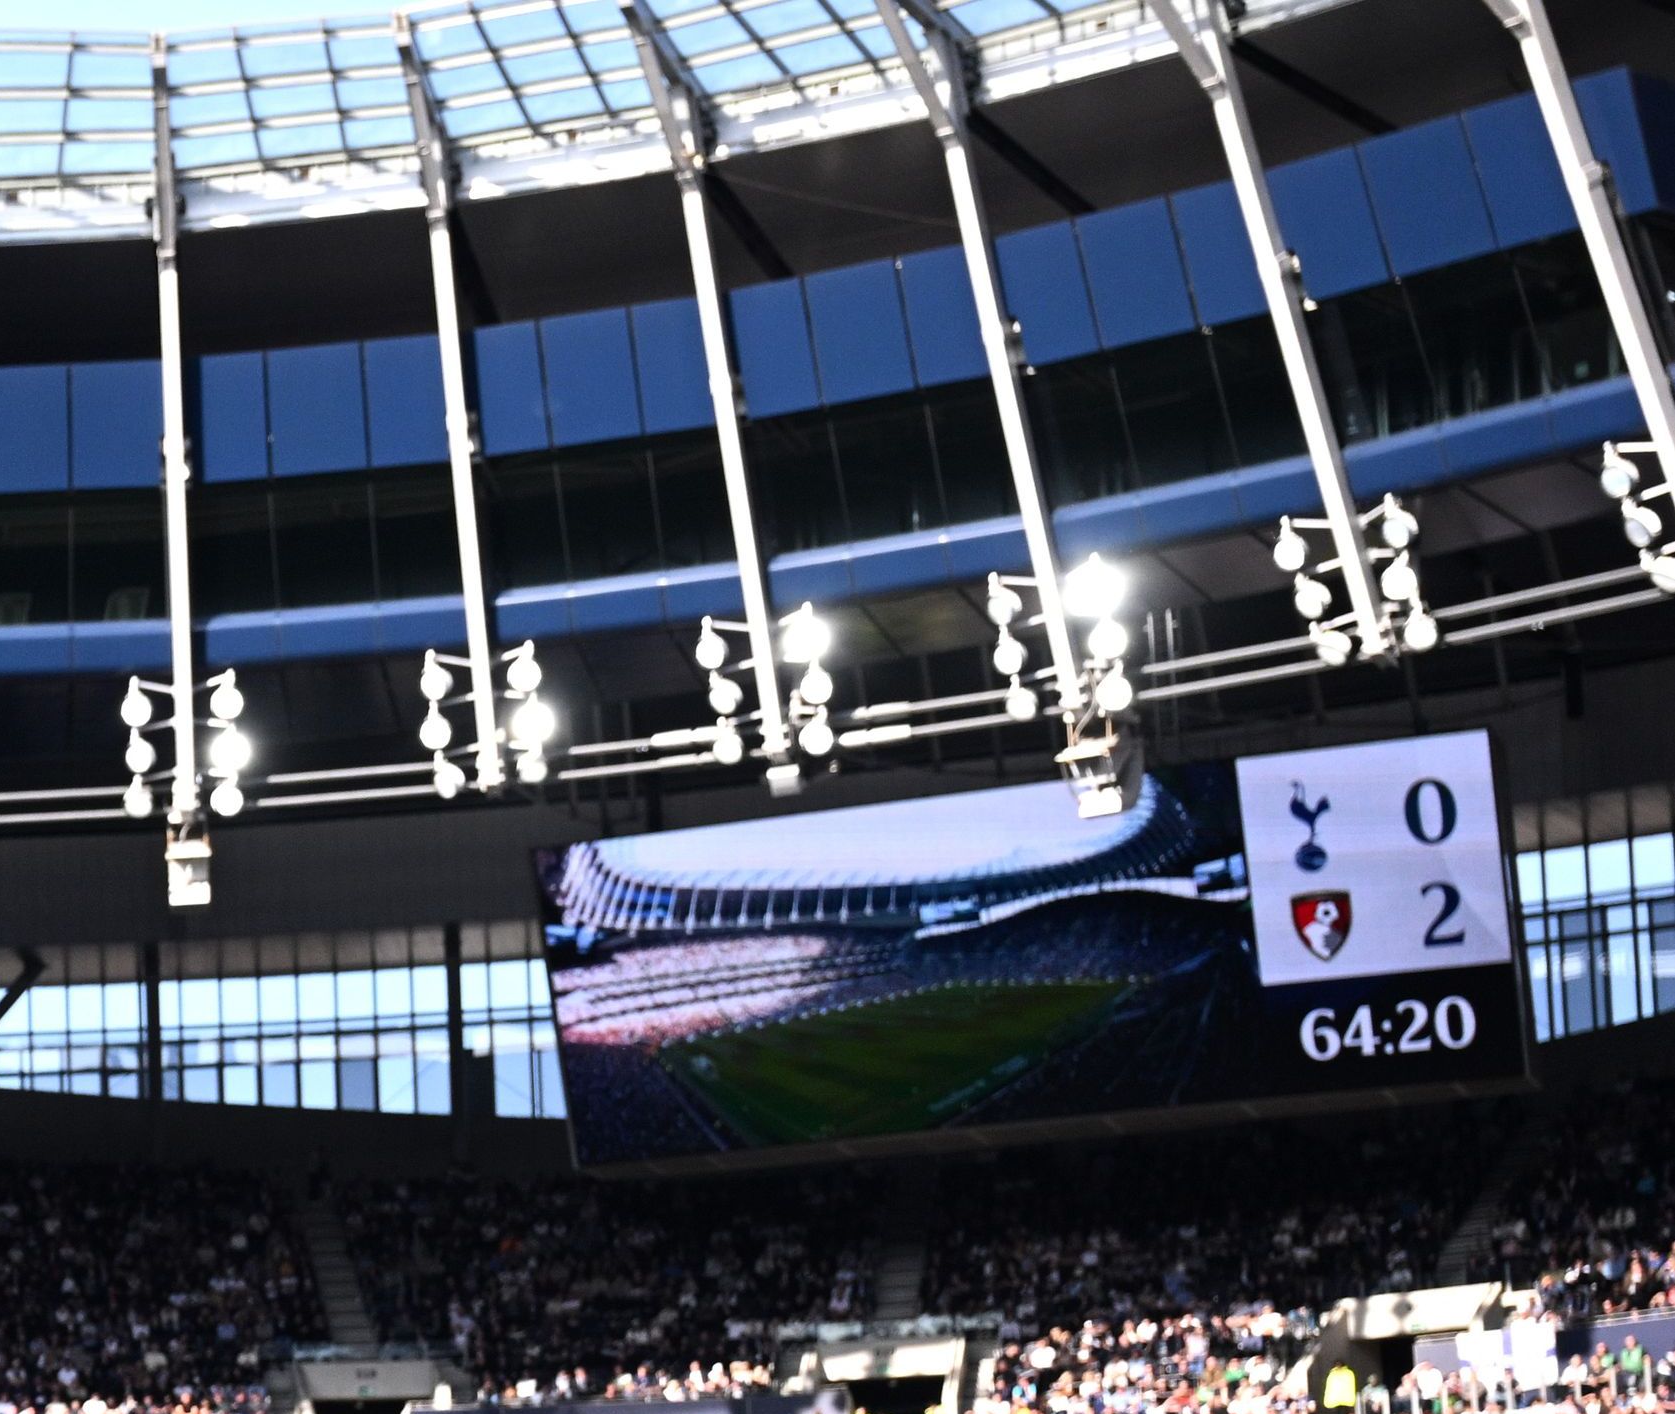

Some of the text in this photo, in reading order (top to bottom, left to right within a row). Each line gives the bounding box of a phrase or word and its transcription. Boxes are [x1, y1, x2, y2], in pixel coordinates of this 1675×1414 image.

[1404, 779, 1457, 844] 0
[1422, 882, 1467, 948] 2
[1299, 996, 1477, 1062] 64:20
